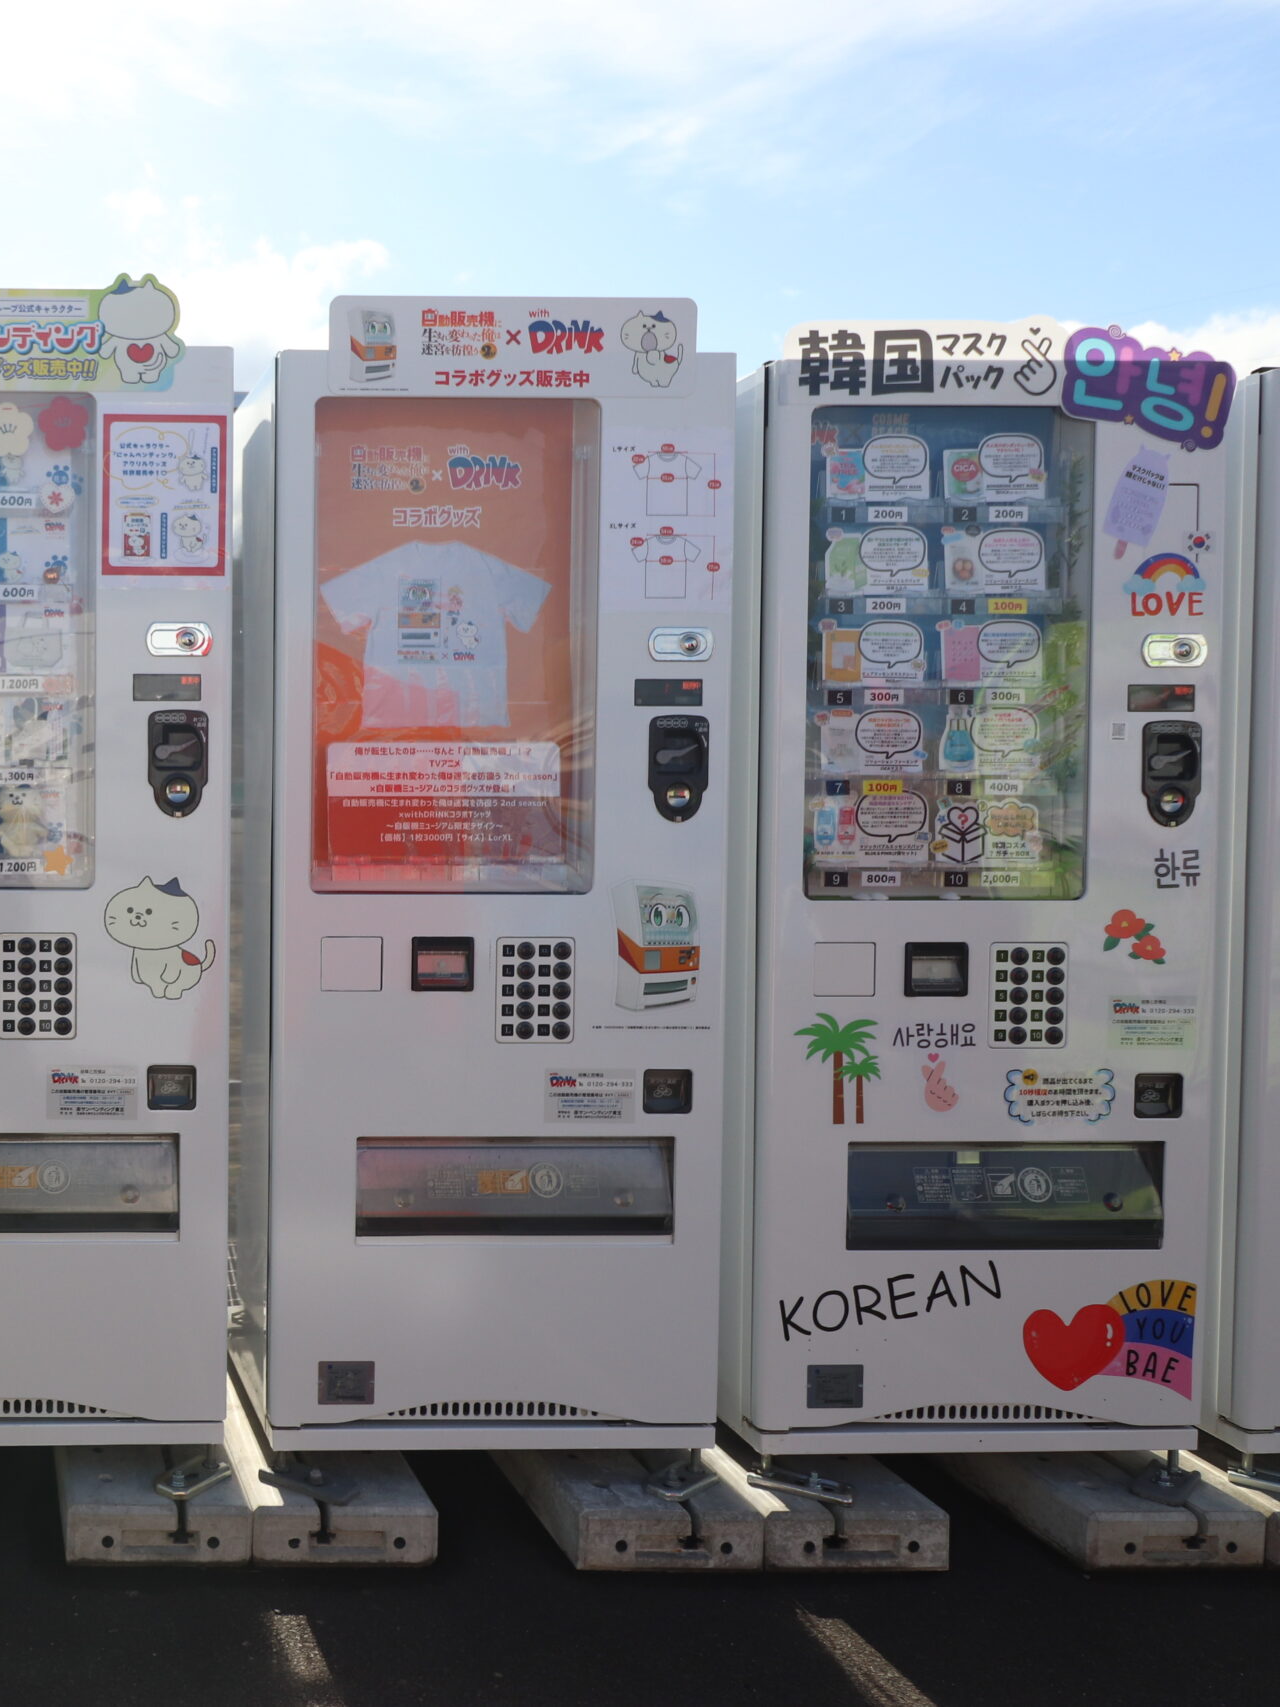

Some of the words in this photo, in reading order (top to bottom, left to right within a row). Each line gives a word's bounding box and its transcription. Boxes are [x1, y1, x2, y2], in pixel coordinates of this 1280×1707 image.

[528, 309, 550, 319] with
[528, 319, 605, 355] DRINK
[937, 332, 1008, 357] マスク
[799, 329, 935, 396] 韓国
[435, 370, 591, 388] コラボグッズ販売中
[940, 364, 1005, 390] パック
[448, 445, 469, 456] with
[448, 456, 521, 490] DRINK
[953, 464, 976, 473] CICA
[0, 496, 32, 507] 600円
[393, 506, 481, 528] コラボグッズ
[874, 510, 903, 520] 200円
[995, 510, 1024, 520] 200円
[3, 587, 35, 598] 600円
[872, 601, 901, 611] 200円
[993, 601, 1023, 611] 100円
[1130, 591, 1204, 617] LOVE
[870, 692, 899, 702] 300円
[991, 692, 1020, 702] 300円
[867, 783, 897, 793] 100円
[989, 783, 1018, 793] 400円
[1154, 848, 1201, 889] 한류
[866, 874, 896, 884] 800円
[983, 874, 1018, 885] 2,000円
[892, 1022, 976, 1049] 사랑해요
[779, 1260, 1002, 1342] KOREAN
[1119, 1281, 1196, 1313] LOVE
[1137, 1316, 1188, 1345] YOU
[1125, 1349, 1180, 1385] BAE
